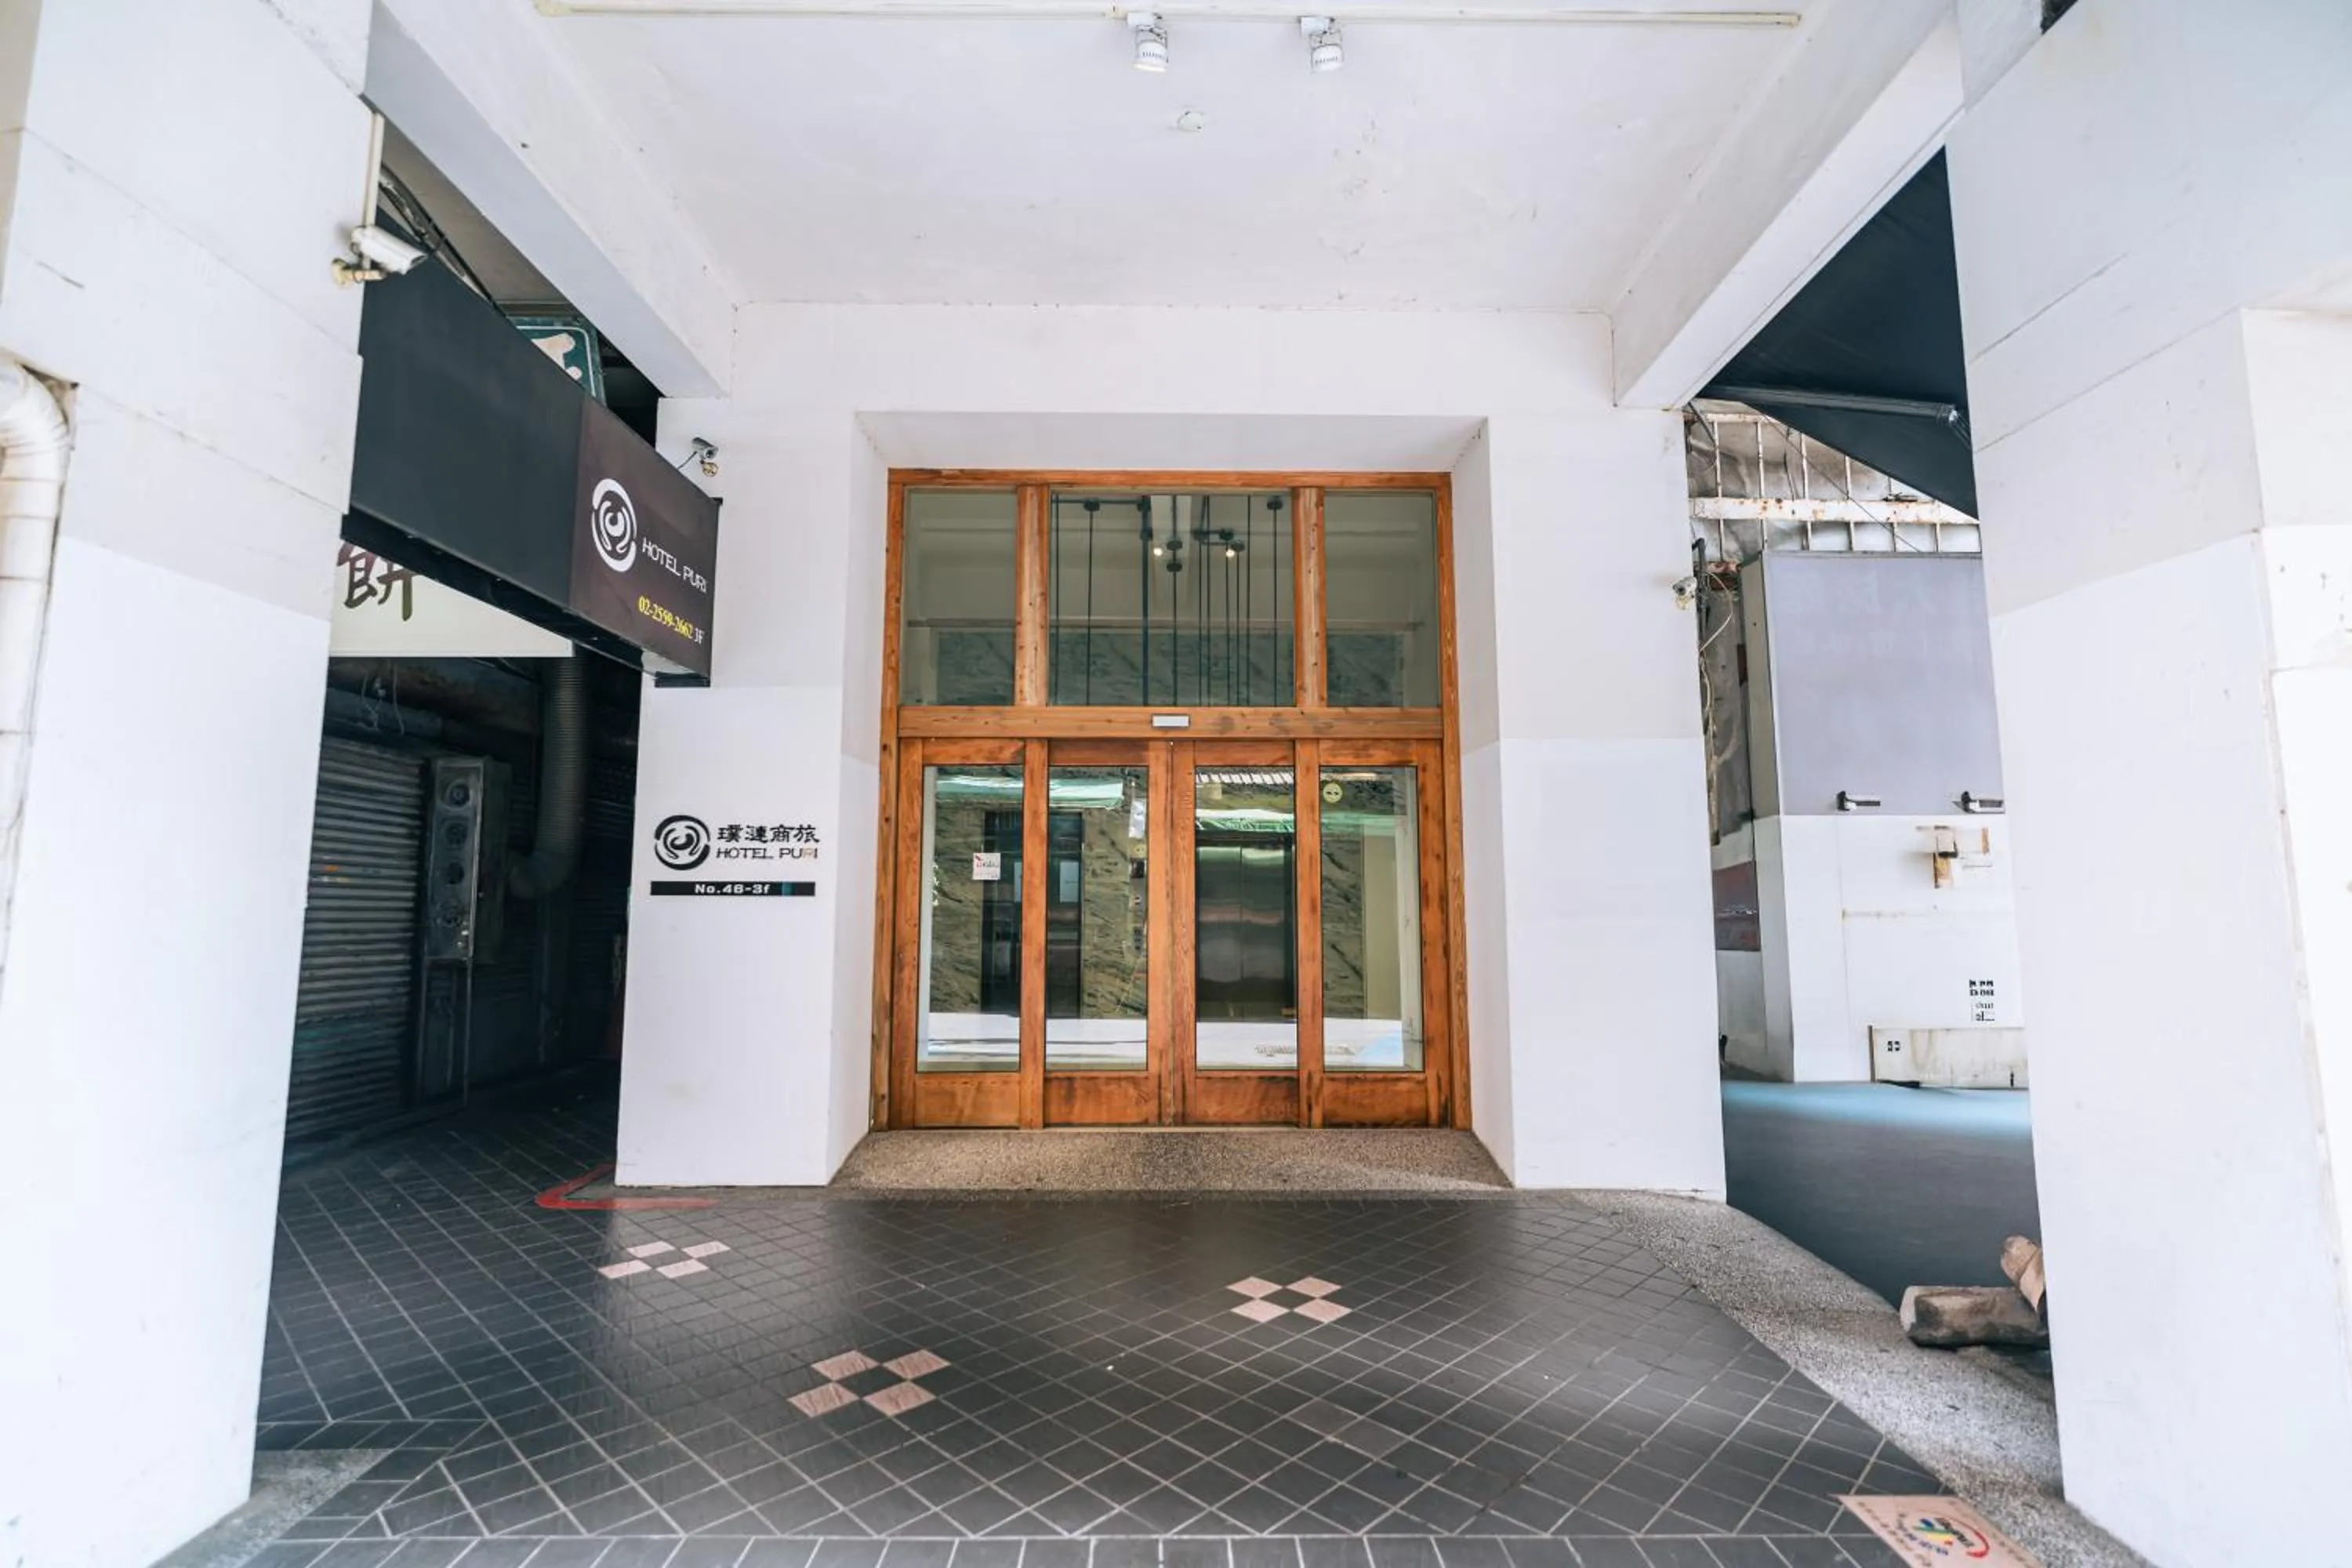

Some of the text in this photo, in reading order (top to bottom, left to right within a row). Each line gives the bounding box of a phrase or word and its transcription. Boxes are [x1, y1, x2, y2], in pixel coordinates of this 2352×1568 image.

[642, 537, 706, 593] HOTEL PURI
[716, 847, 774, 859] HOTEL
